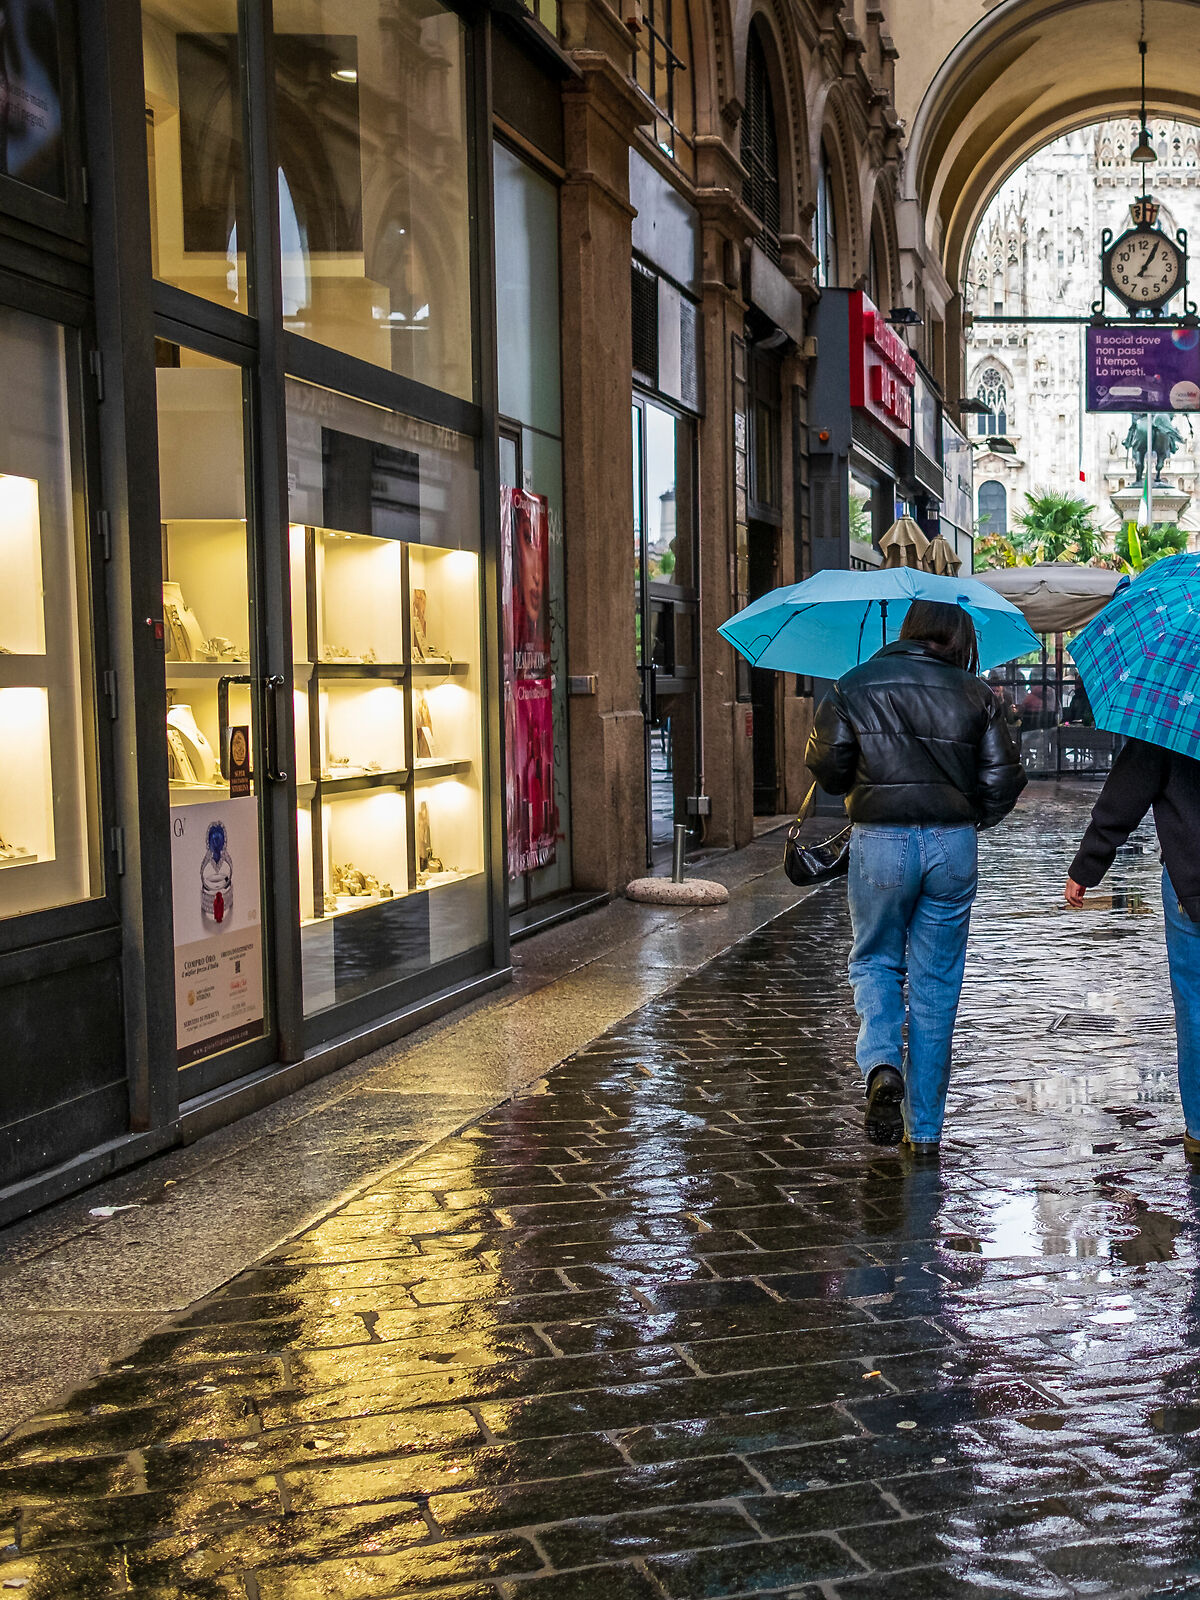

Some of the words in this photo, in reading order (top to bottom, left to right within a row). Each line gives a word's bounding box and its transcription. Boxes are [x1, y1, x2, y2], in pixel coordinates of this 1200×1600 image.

[1128, 244, 1135, 253] 11
[1138, 240, 1149, 250] 12
[1119, 252, 1130, 261] 10
[1162, 252, 1168, 261] 2
[1117, 264, 1124, 273] 9
[1165, 263, 1172, 272] 3
[1122, 275, 1129, 284] 8
[1161, 275, 1168, 284] 4
[1131, 284, 1137, 293] 7
[1141, 287, 1149, 296] 6
[1153, 284, 1160, 292] 5
[1096, 335, 1101, 345] Il
[1103, 335, 1134, 345] social
[1135, 335, 1161, 345] dove
[1096, 347, 1115, 355] non
[1117, 346, 1145, 356] passi
[1096, 357, 1101, 366] il
[1103, 357, 1139, 367] tempo.
[1096, 367, 1109, 376] Lo
[1110, 367, 1146, 376] investi.
